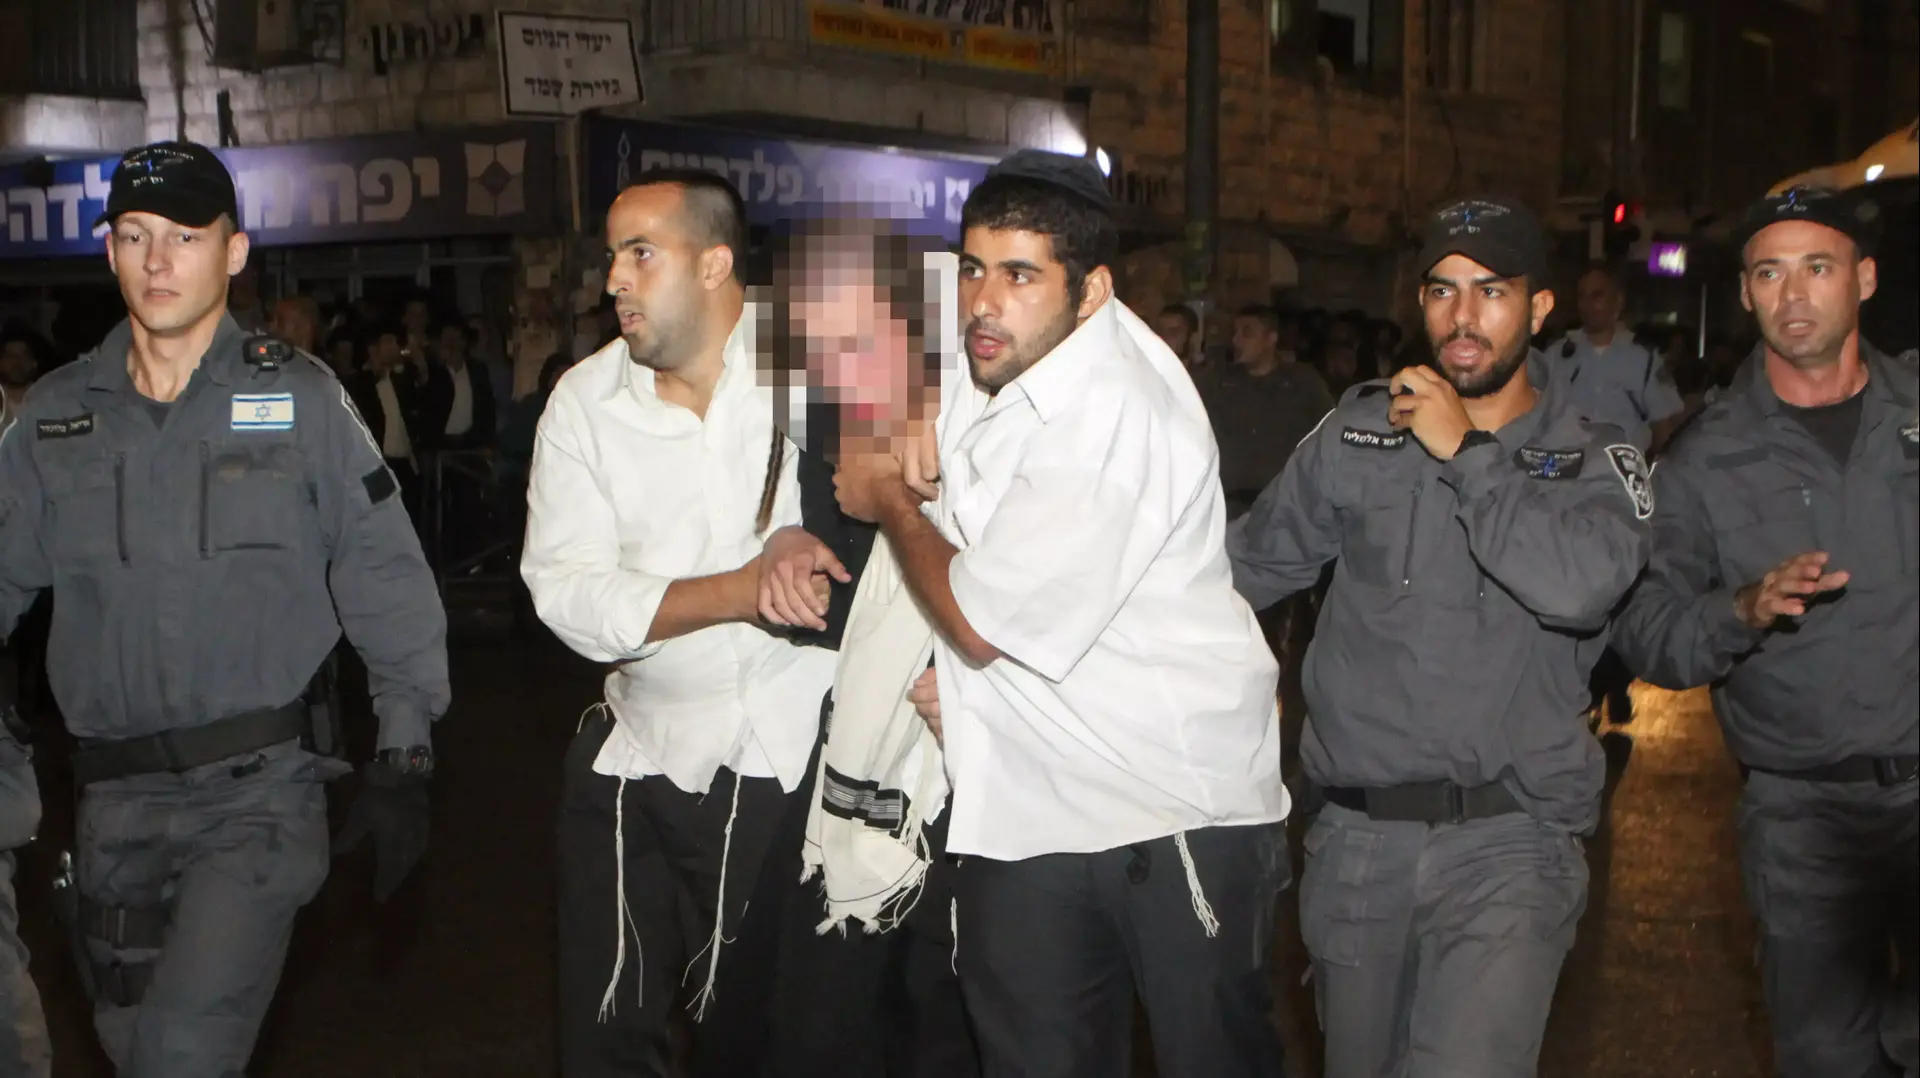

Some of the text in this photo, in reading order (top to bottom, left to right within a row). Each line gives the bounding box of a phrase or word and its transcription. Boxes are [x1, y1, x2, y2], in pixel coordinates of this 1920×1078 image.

[522, 28, 612, 51] יעדי הגיוס
[524, 76, 622, 98] גזירת שמד
[309, 156, 440, 227] יפה
[1343, 431, 1379, 445] אלמליח
